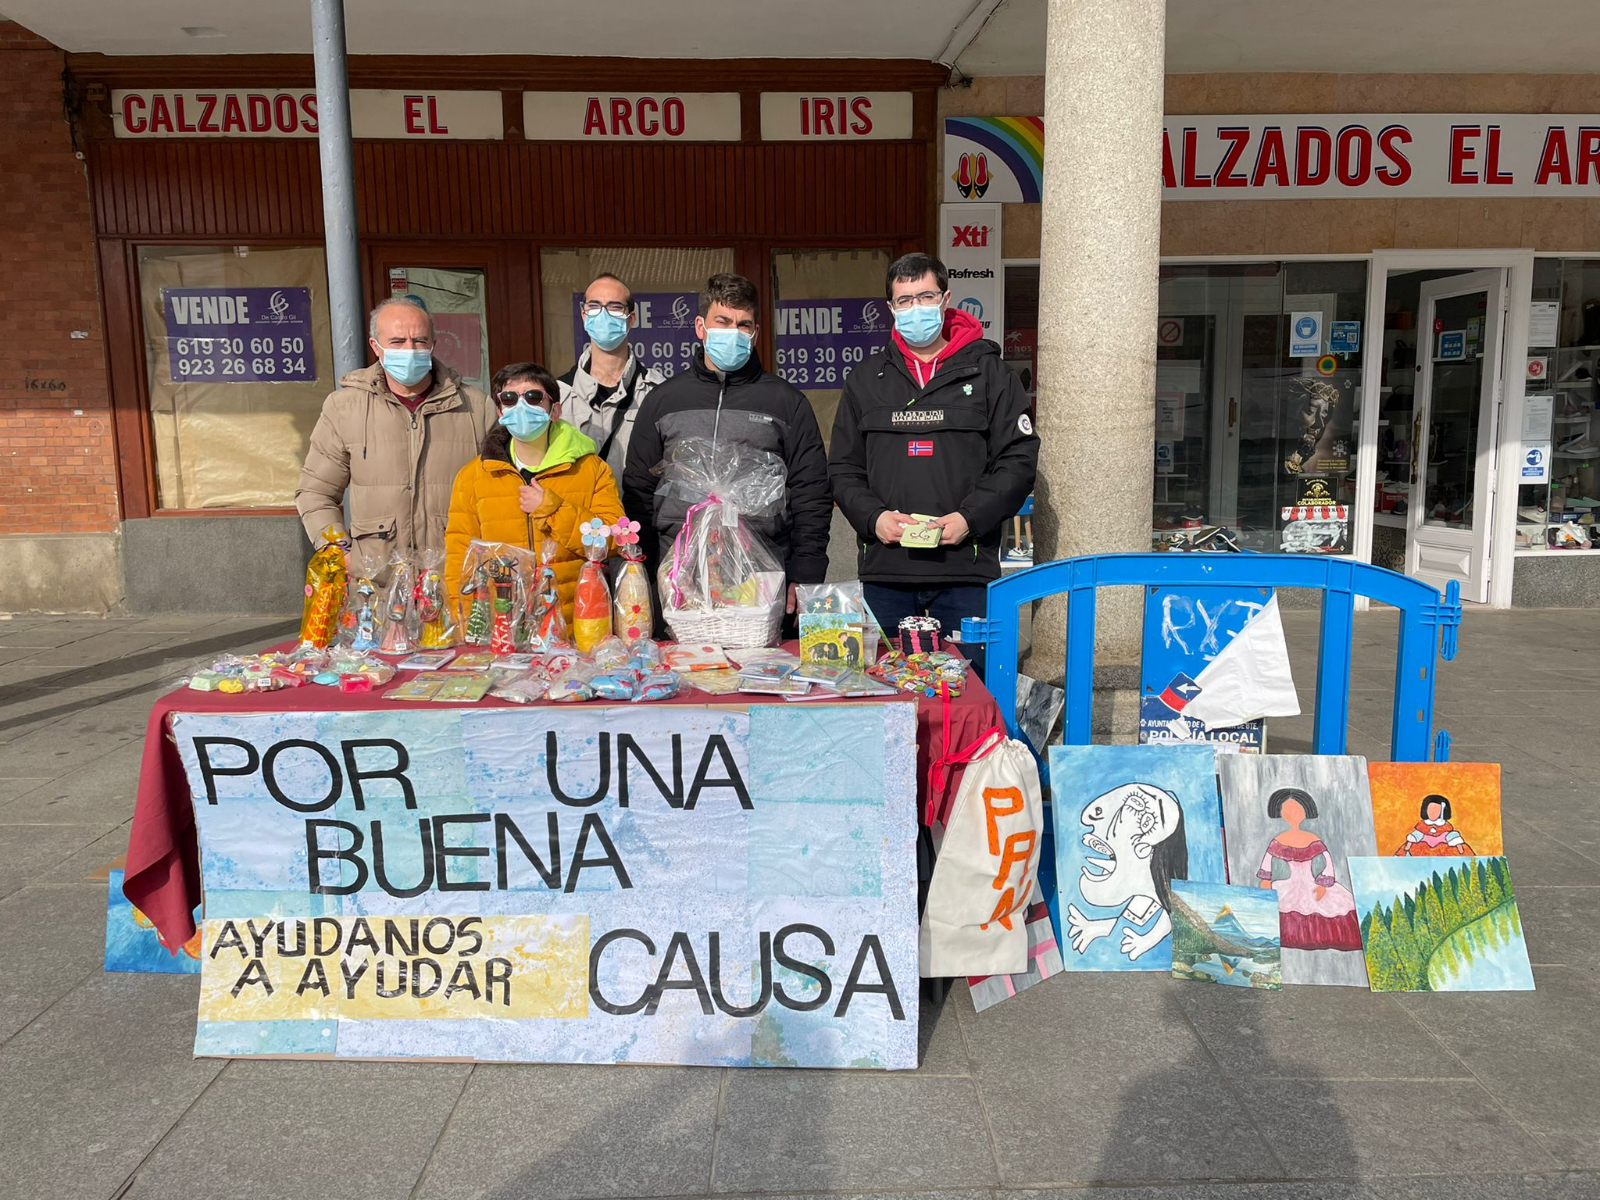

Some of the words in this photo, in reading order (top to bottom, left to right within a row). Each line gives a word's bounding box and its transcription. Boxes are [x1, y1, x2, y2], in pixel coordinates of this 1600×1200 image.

[122, 94, 319, 134] CALZADOS
[403, 95, 449, 134] EL
[583, 96, 686, 136] ARCO
[800, 96, 873, 136] IRIS
[1447, 125, 1514, 185] EL
[951, 225, 990, 248] Xti
[171, 296, 250, 325] VENDE
[775, 307, 843, 335] VENDE
[177, 338, 214, 355] 619
[220, 338, 244, 355] 30
[250, 338, 274, 354] 60
[281, 337, 304, 354] 50
[652, 342, 674, 358] 60
[776, 348, 809, 364] 619
[815, 347, 836, 363] 30
[842, 346, 864, 362] 60
[178, 359, 216, 376] 923
[221, 358, 246, 375] 26
[252, 358, 276, 375] 68
[282, 357, 307, 374] 34
[815, 367, 837, 382] 26
[1210, 731, 1259, 744] LOCAL
[192, 735, 418, 813] POR
[546, 731, 754, 811] UNA
[307, 812, 634, 898] BUENA
[210, 916, 484, 960] AYUDANOS
[232, 958, 275, 998] A
[296, 956, 512, 1006] AYUDAR
[589, 923, 906, 1020] CAUSA
